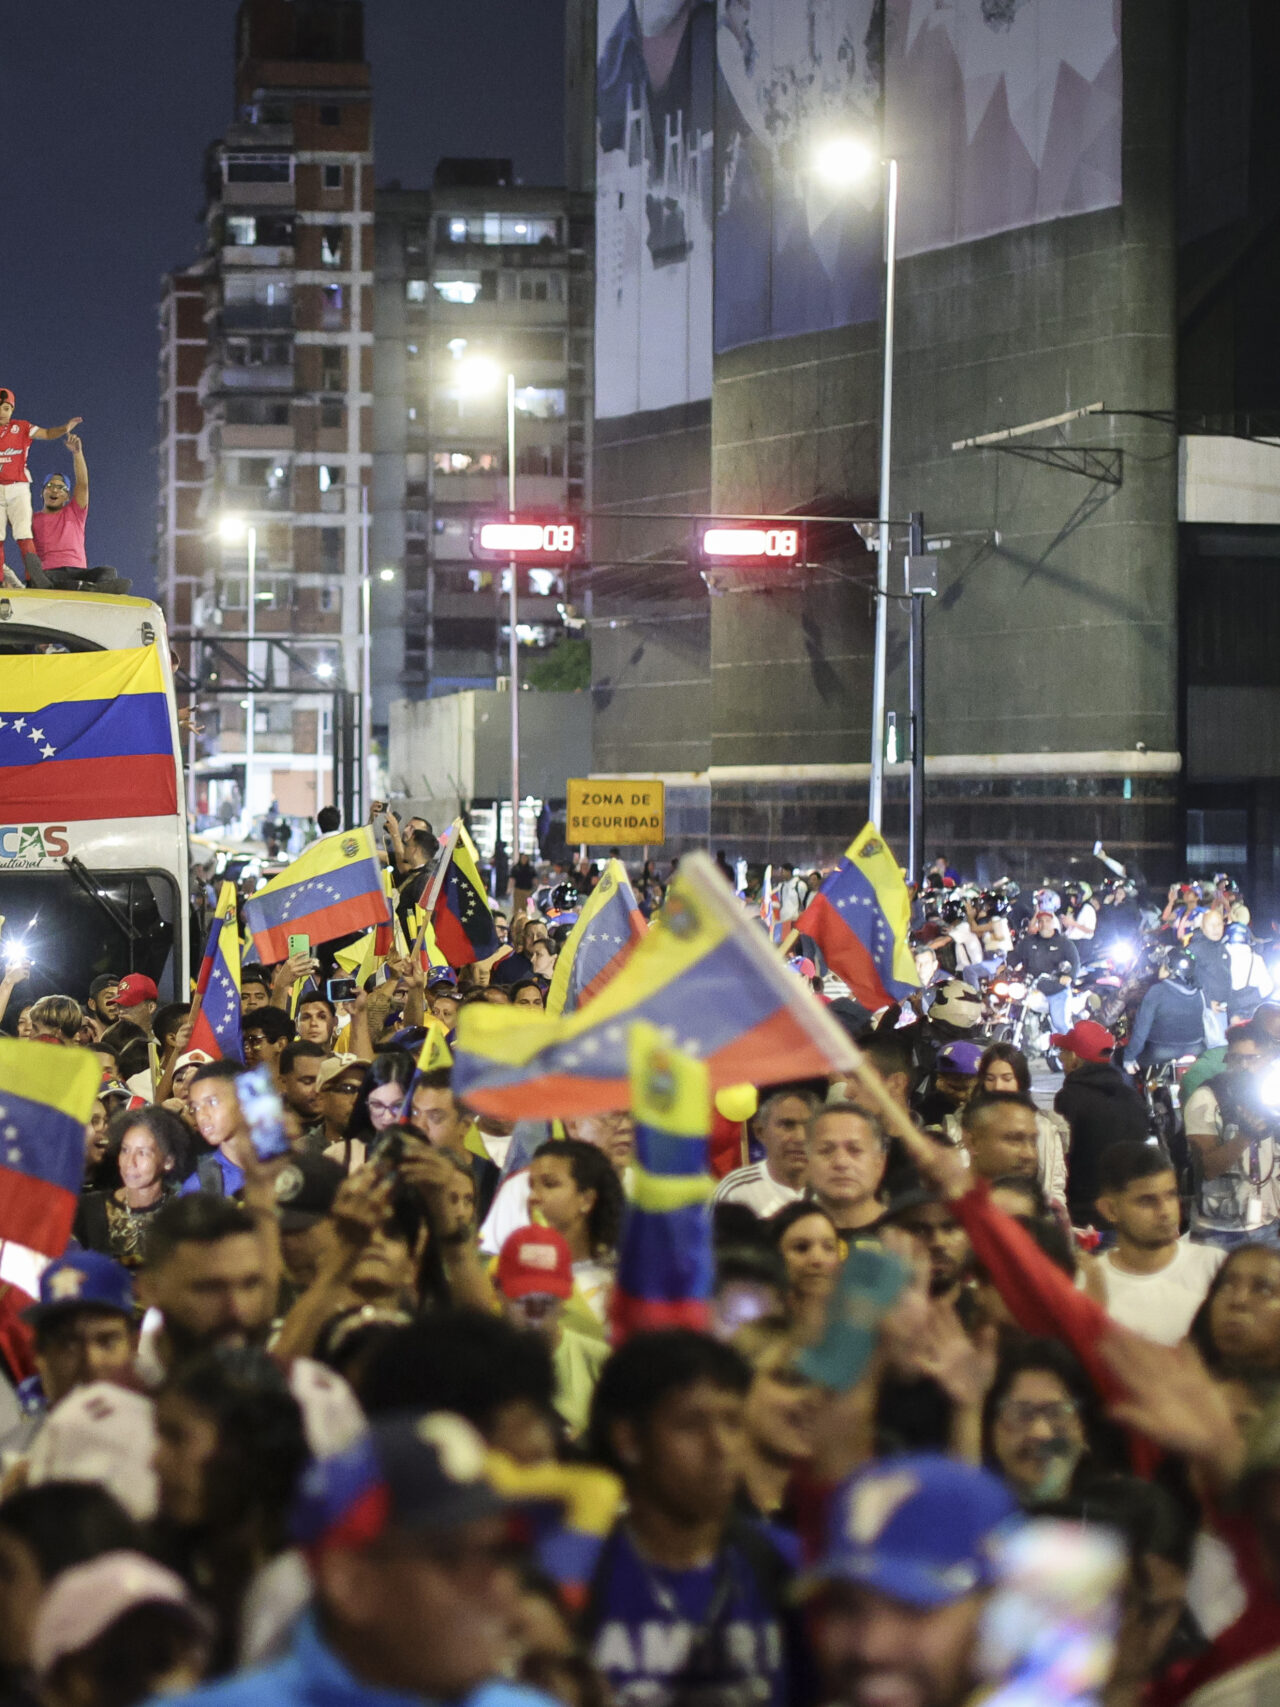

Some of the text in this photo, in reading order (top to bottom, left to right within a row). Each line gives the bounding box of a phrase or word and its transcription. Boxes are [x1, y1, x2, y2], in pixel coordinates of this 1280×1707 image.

[543, 525, 574, 552] 08
[765, 530, 797, 556] 08
[581, 793, 651, 805] ZONA DE
[572, 815, 660, 828] SEGURIDAD
